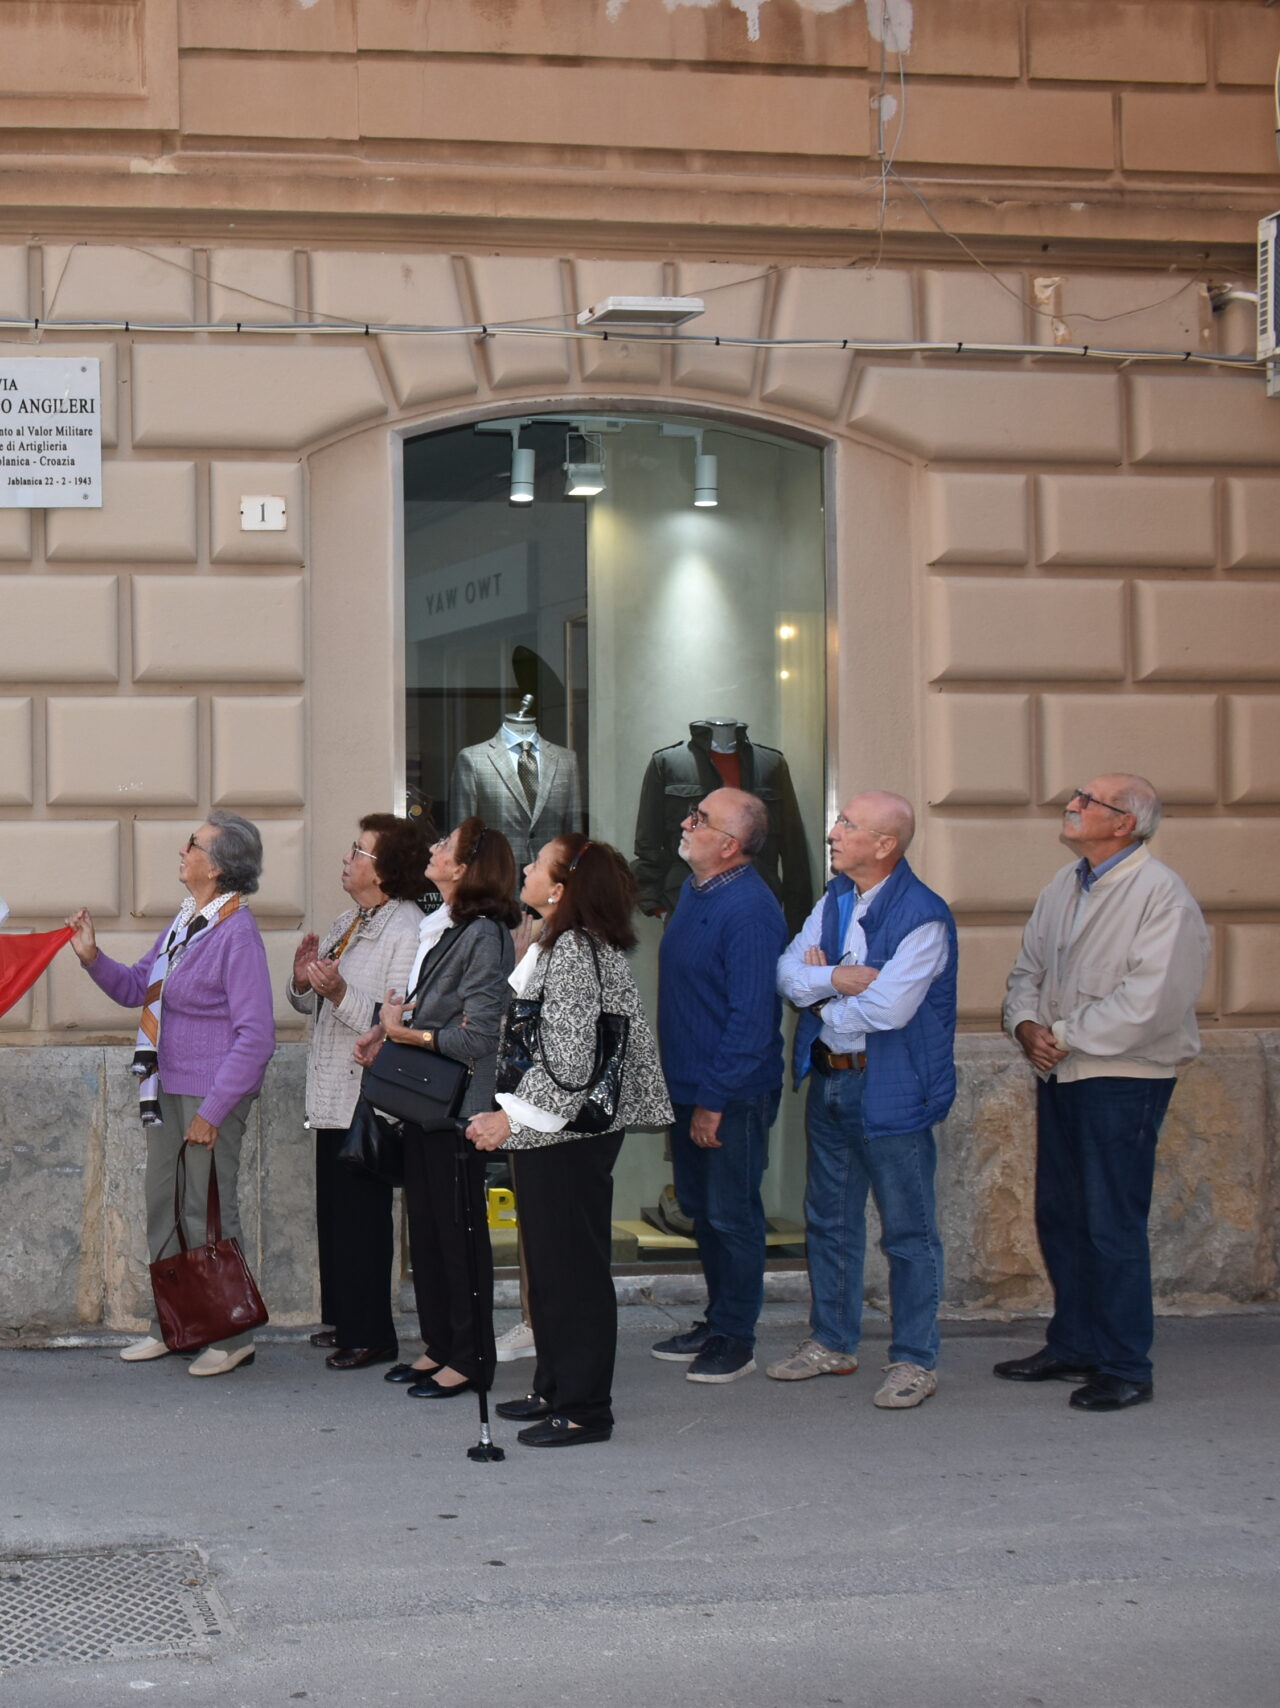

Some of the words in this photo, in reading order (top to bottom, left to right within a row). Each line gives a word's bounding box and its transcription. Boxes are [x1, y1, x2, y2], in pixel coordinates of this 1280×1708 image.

[17, 398, 96, 414] ANGILERI
[15, 426, 25, 437] al
[27, 426, 53, 437] Valor
[55, 426, 94, 437] Militare
[6, 441, 16, 452] di
[18, 441, 68, 454] Artiglieria
[39, 456, 76, 467] Croazia
[8, 477, 43, 486] Jablanica
[44, 477, 54, 486] 22
[74, 477, 92, 486] 1943
[260, 502, 266, 522] 1
